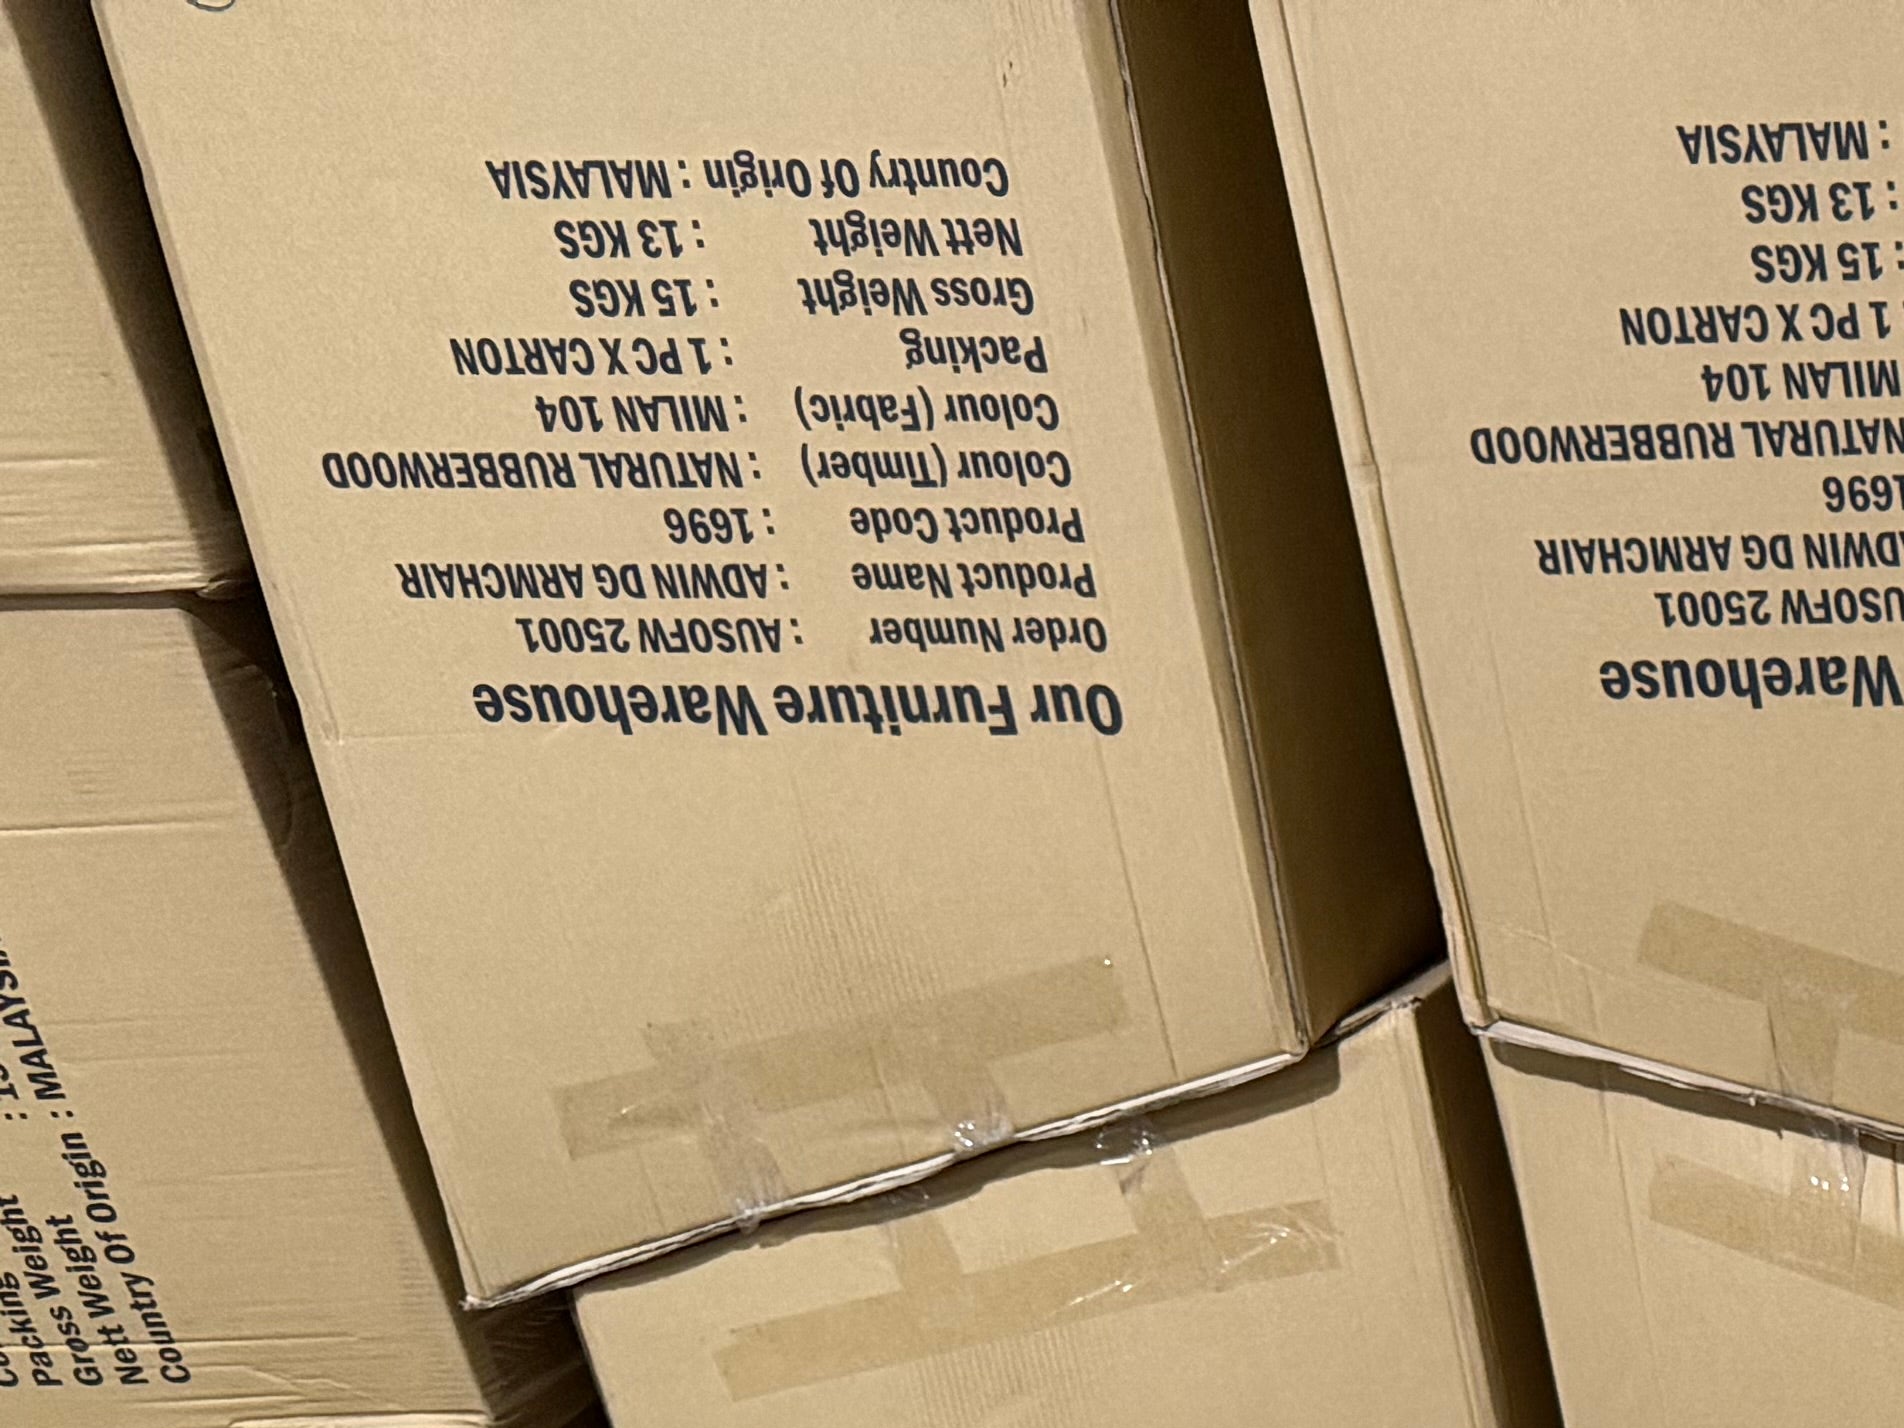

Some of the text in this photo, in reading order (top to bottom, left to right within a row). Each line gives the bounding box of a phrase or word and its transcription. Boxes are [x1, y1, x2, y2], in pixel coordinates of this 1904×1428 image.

[448, 327, 1047, 375] Packing 1 PC X CARTON
[1469, 421, 1734, 464] RUBBERWOOD
[1533, 534, 1731, 575] ARMCHAIR
[1739, 533, 1793, 569] DG
[514, 616, 1107, 653] Order Number AUSOFW 25001
[1598, 654, 1904, 709] Warehouse
[471, 683, 1122, 736] Our Furniture Warehouse
[60, 1131, 117, 1222] Origin
[93, 1229, 135, 1263] Of
[0, 1193, 104, 1385] Gross Weight
[44, 1214, 151, 1386] Nett Weight
[119, 1271, 191, 1383] Country
